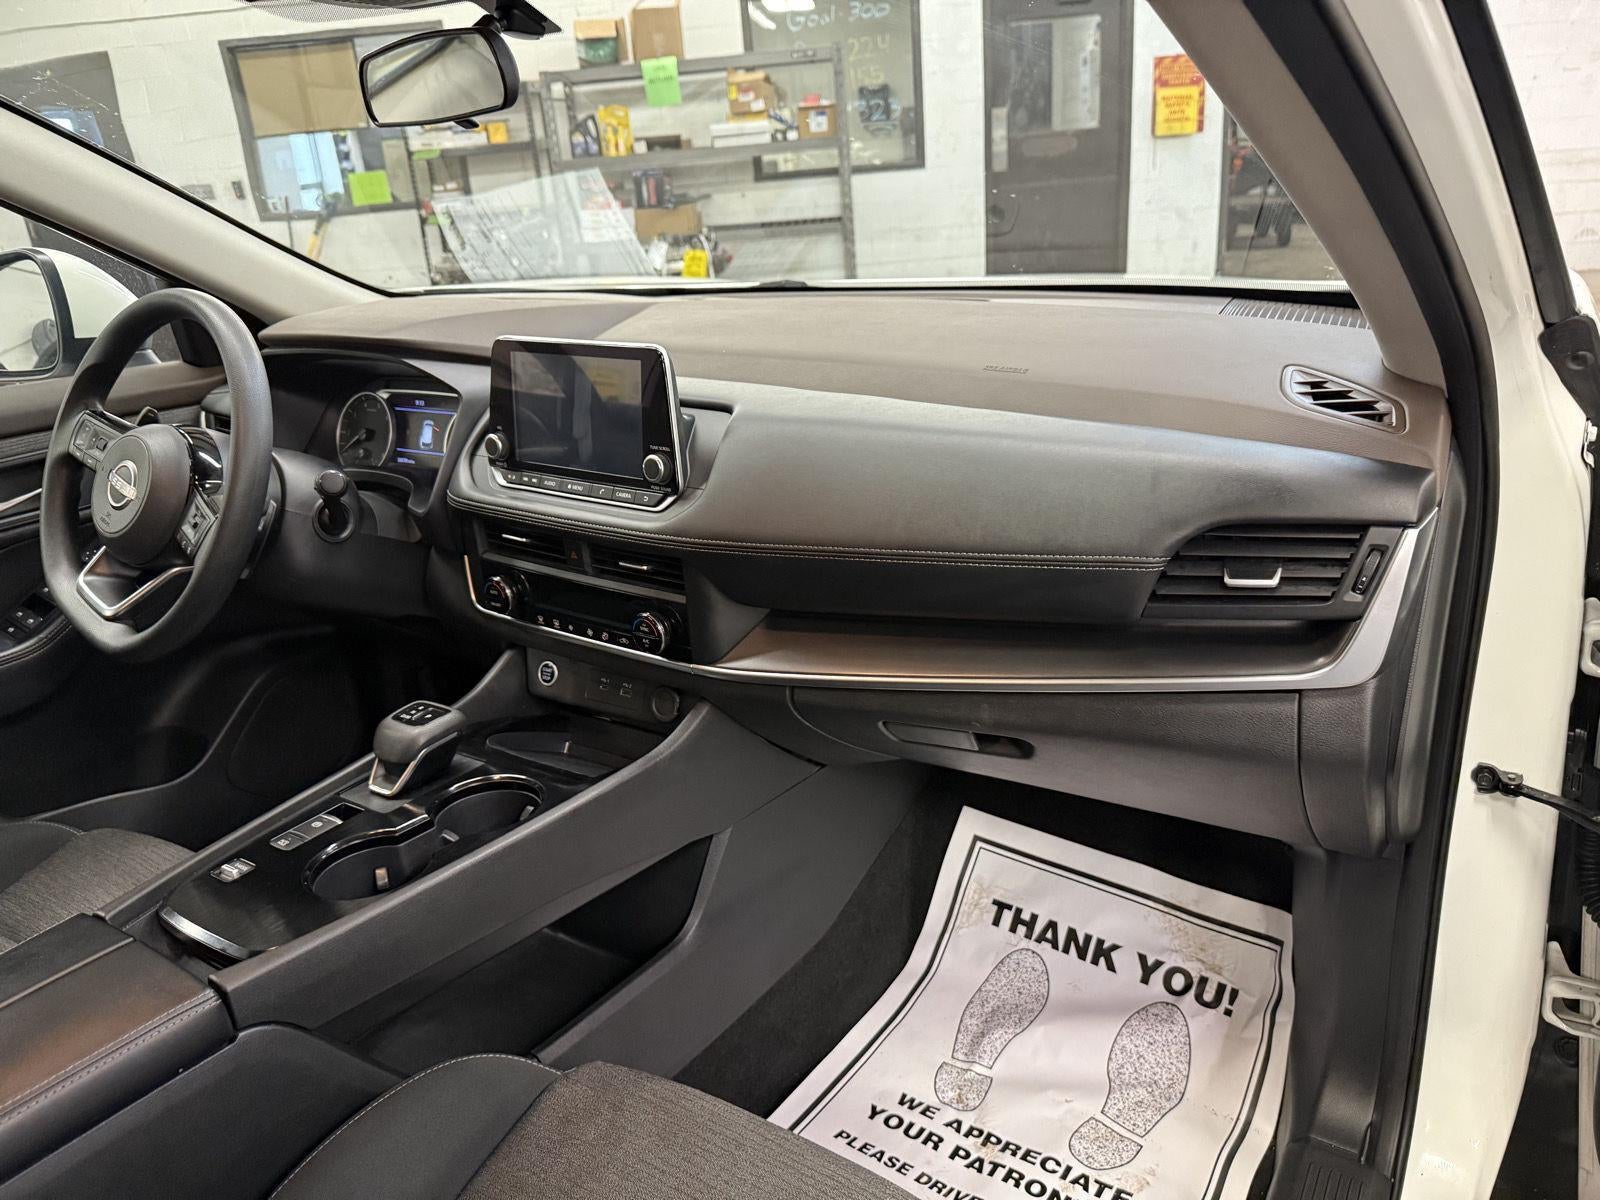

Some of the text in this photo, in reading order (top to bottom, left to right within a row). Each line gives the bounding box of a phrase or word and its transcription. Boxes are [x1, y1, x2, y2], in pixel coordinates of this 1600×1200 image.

[849, 0, 890, 19] 300
[991, 898, 1240, 1017] THANK YOU!
[868, 1104, 944, 1151] YOUR
[898, 1092, 1134, 1200] WE APPRECIATE
[833, 1129, 914, 1176] PLEASE
